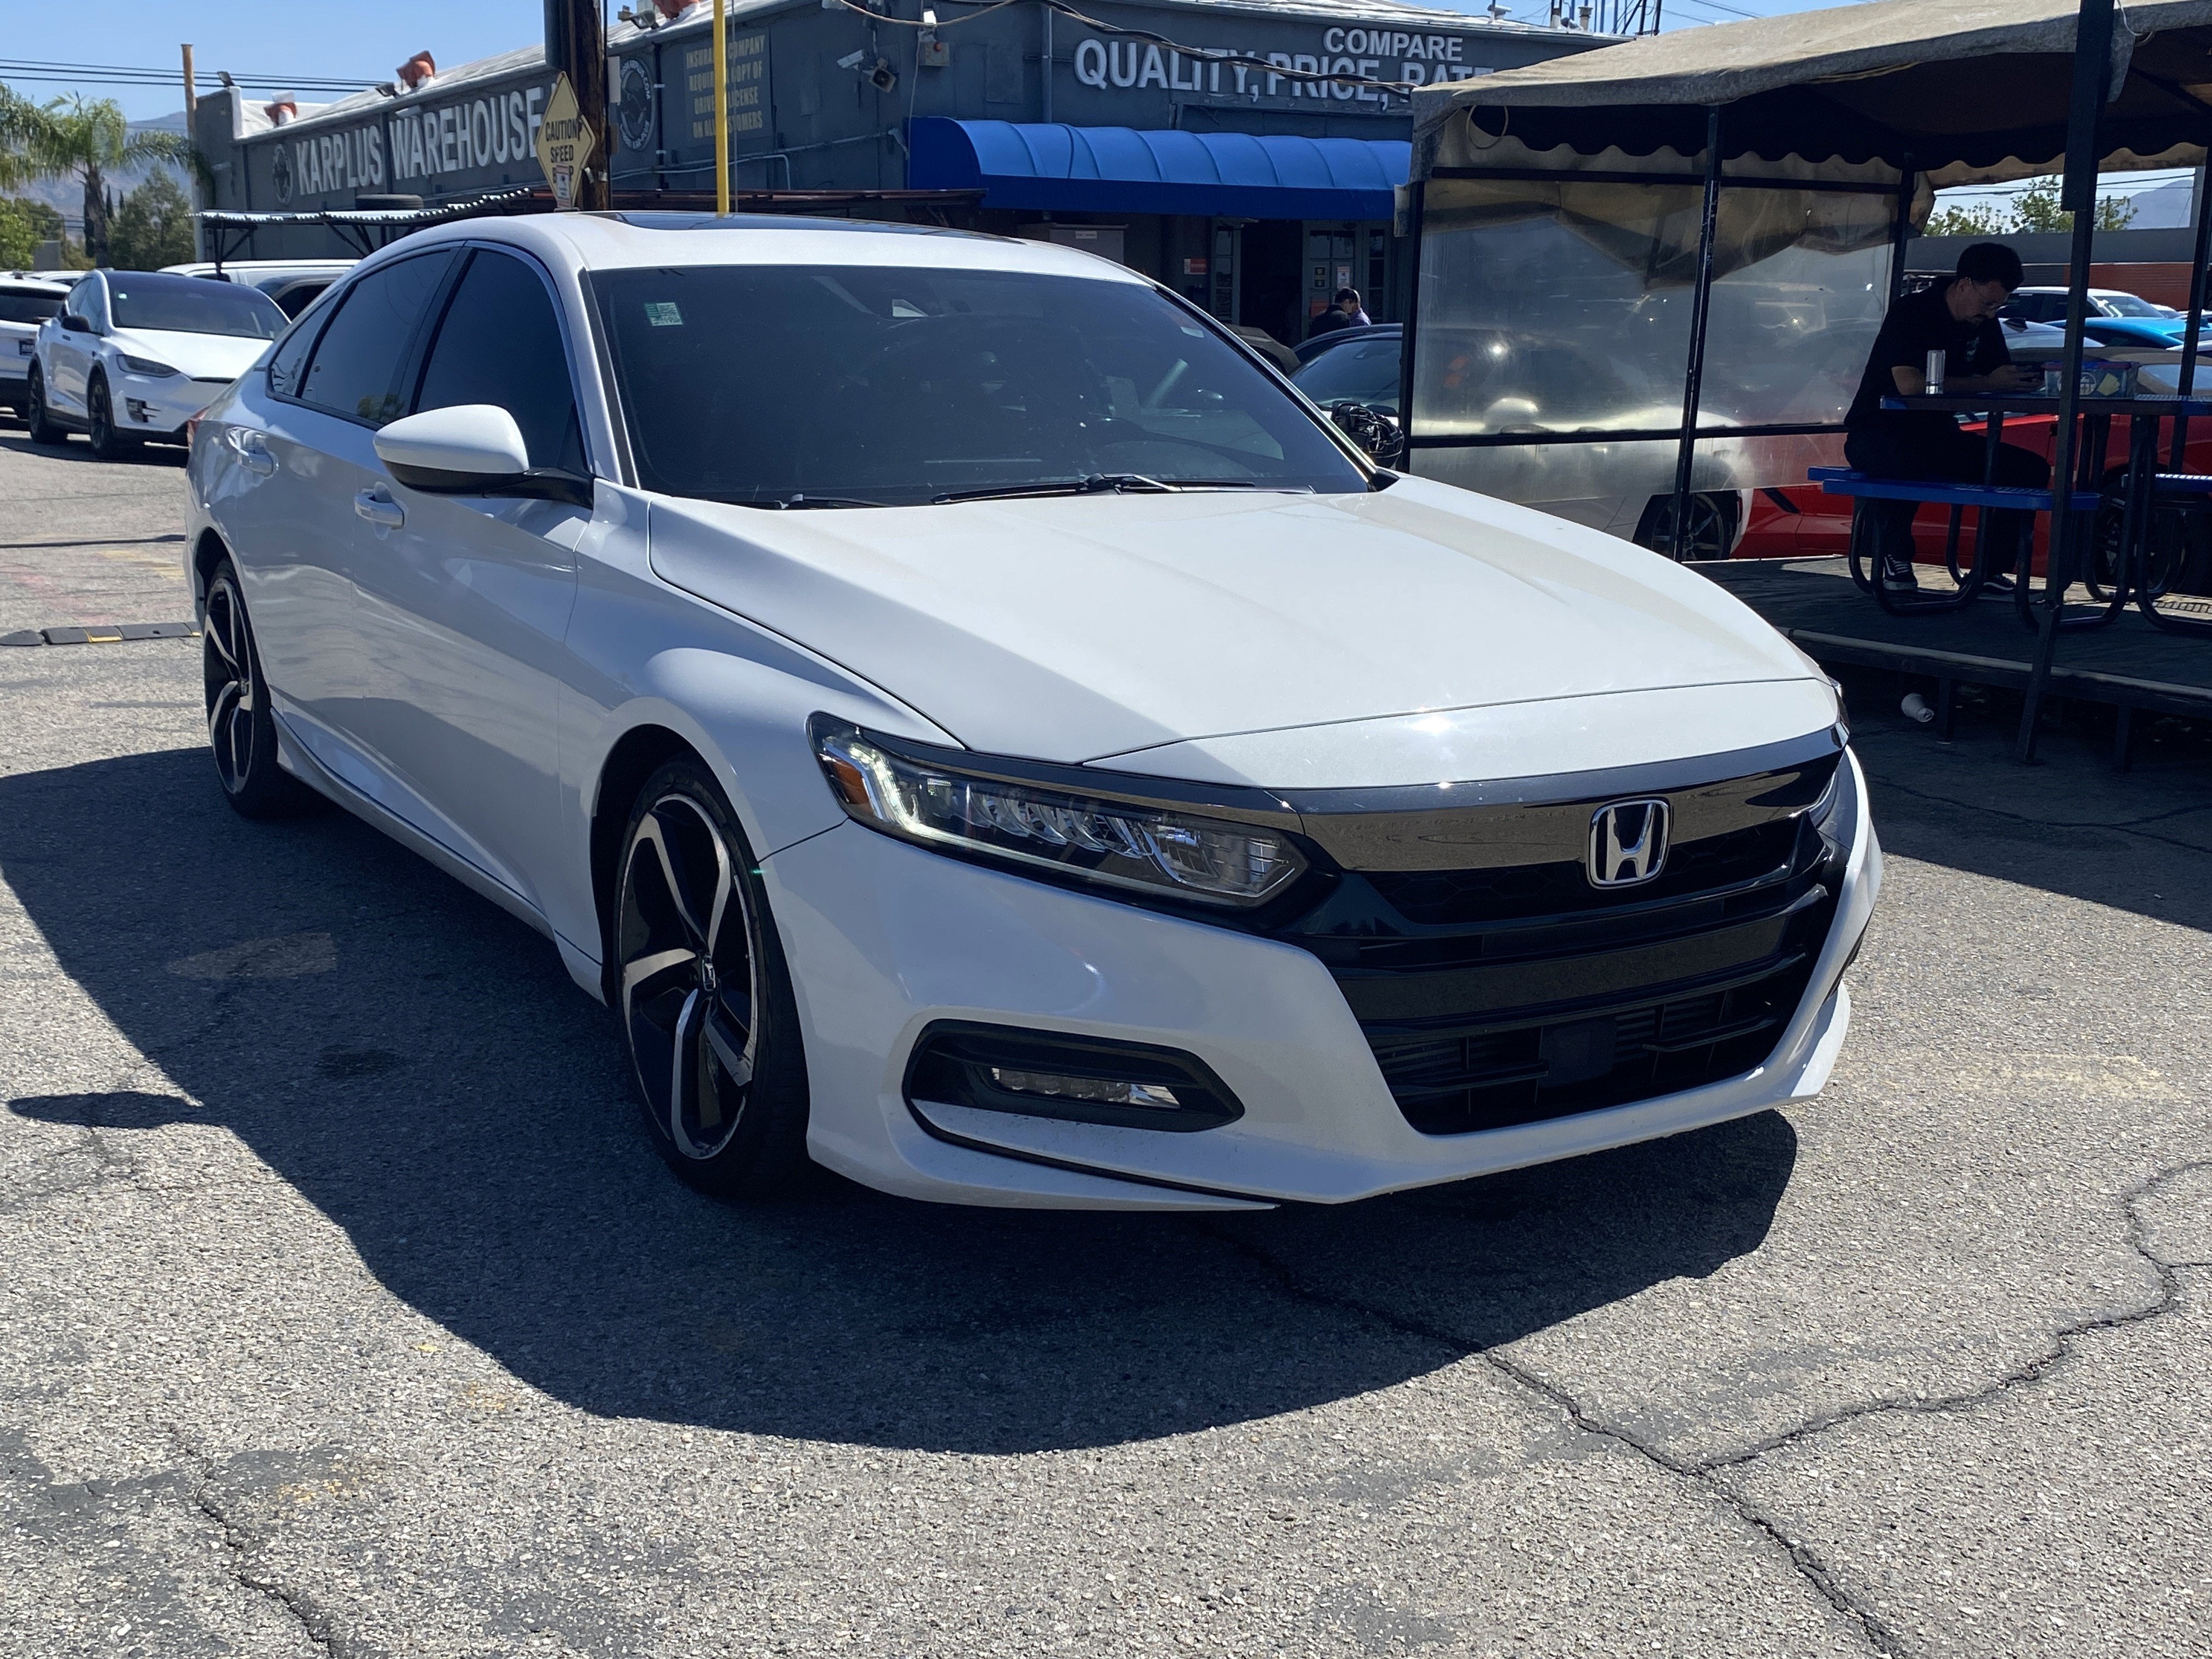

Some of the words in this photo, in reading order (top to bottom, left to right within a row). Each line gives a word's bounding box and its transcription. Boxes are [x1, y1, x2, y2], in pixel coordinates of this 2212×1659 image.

[687, 47, 713, 69] INSURA
[727, 34, 765, 60] COMPANY
[1323, 27, 1463, 61] COMPARE
[753, 60, 763, 79] OF
[1074, 38, 1259, 103] QUALITY,
[1267, 52, 1388, 110] PRICE,
[727, 86, 758, 109] LICENSE
[545, 118, 577, 142] CAUTION
[728, 110, 763, 133] STOMERS
[295, 125, 383, 195] KARPLUS
[388, 86, 544, 179] WAREHOUSE
[550, 145, 573, 163] SPEED
[552, 166, 573, 184] BP
